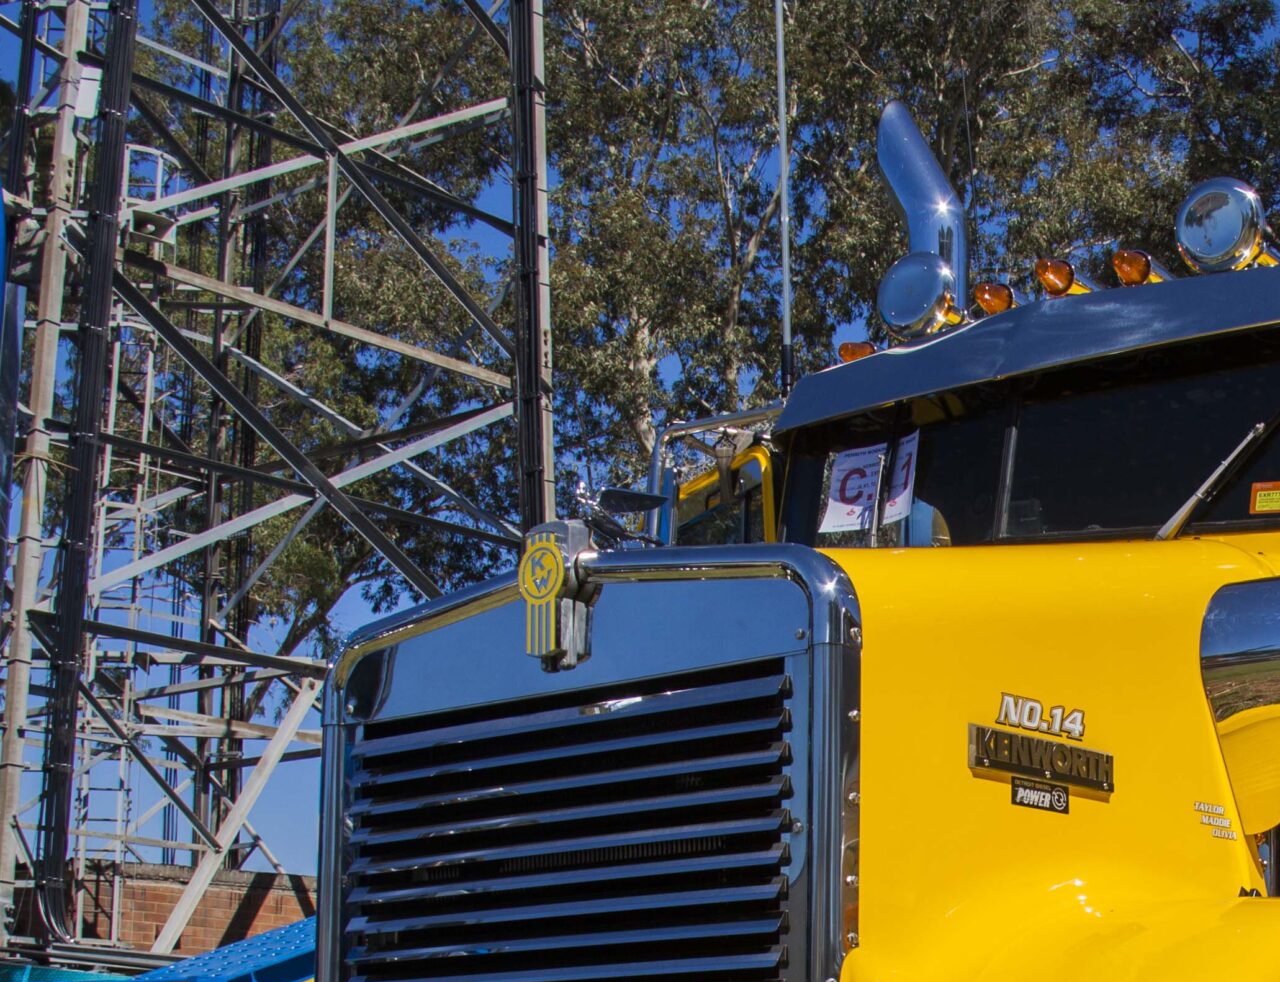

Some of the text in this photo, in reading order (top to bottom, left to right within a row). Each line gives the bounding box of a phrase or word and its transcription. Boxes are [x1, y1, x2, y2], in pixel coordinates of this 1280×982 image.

[996, 692, 1085, 741] NO.14
[976, 727, 1114, 783] KENWORTH
[1016, 787, 1051, 808] POWER
[1194, 801, 1225, 816] TAYLOR
[1201, 815, 1231, 828] MADDIE
[1212, 828, 1237, 841] OLIVIA
